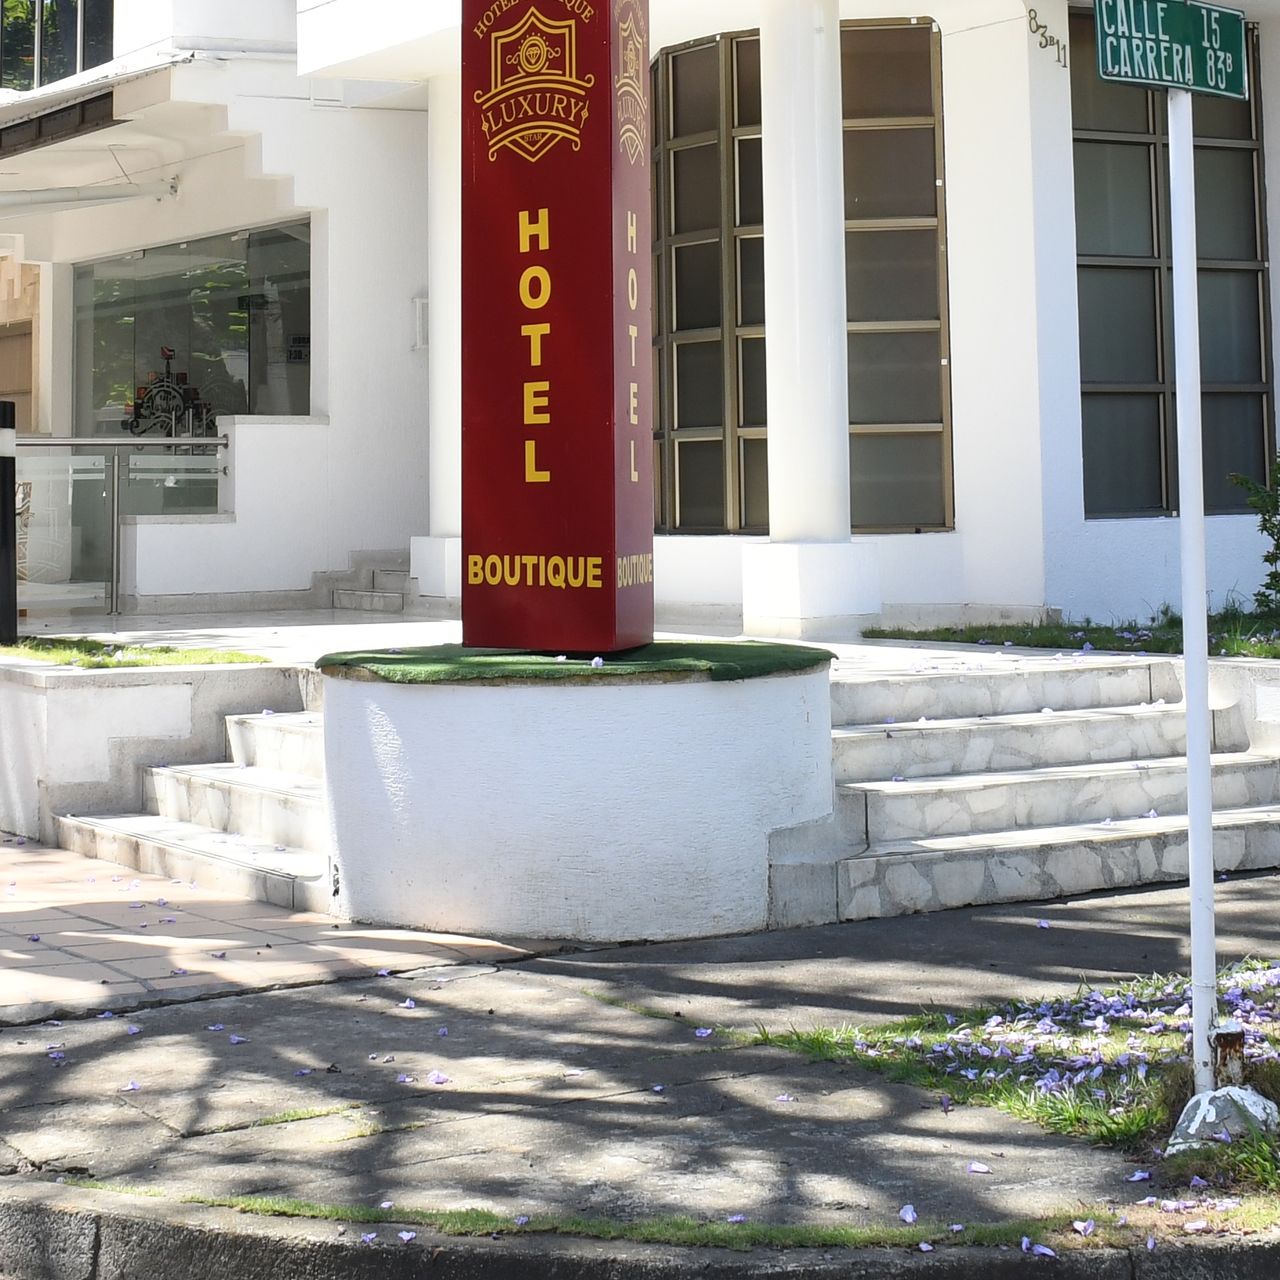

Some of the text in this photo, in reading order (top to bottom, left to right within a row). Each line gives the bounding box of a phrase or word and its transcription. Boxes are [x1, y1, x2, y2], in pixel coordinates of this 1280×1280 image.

[1201, 8, 1220, 49] 15
[1106, 36, 1233, 90] CARRERA 83B
[486, 93, 584, 132] LUXURY
[523, 133, 543, 142] STAR
[518, 208, 551, 483] HOTEL
[627, 210, 638, 483] HOTEL
[467, 554, 603, 589] BOUTIQUE
[618, 553, 652, 588] BOUTIQUE
